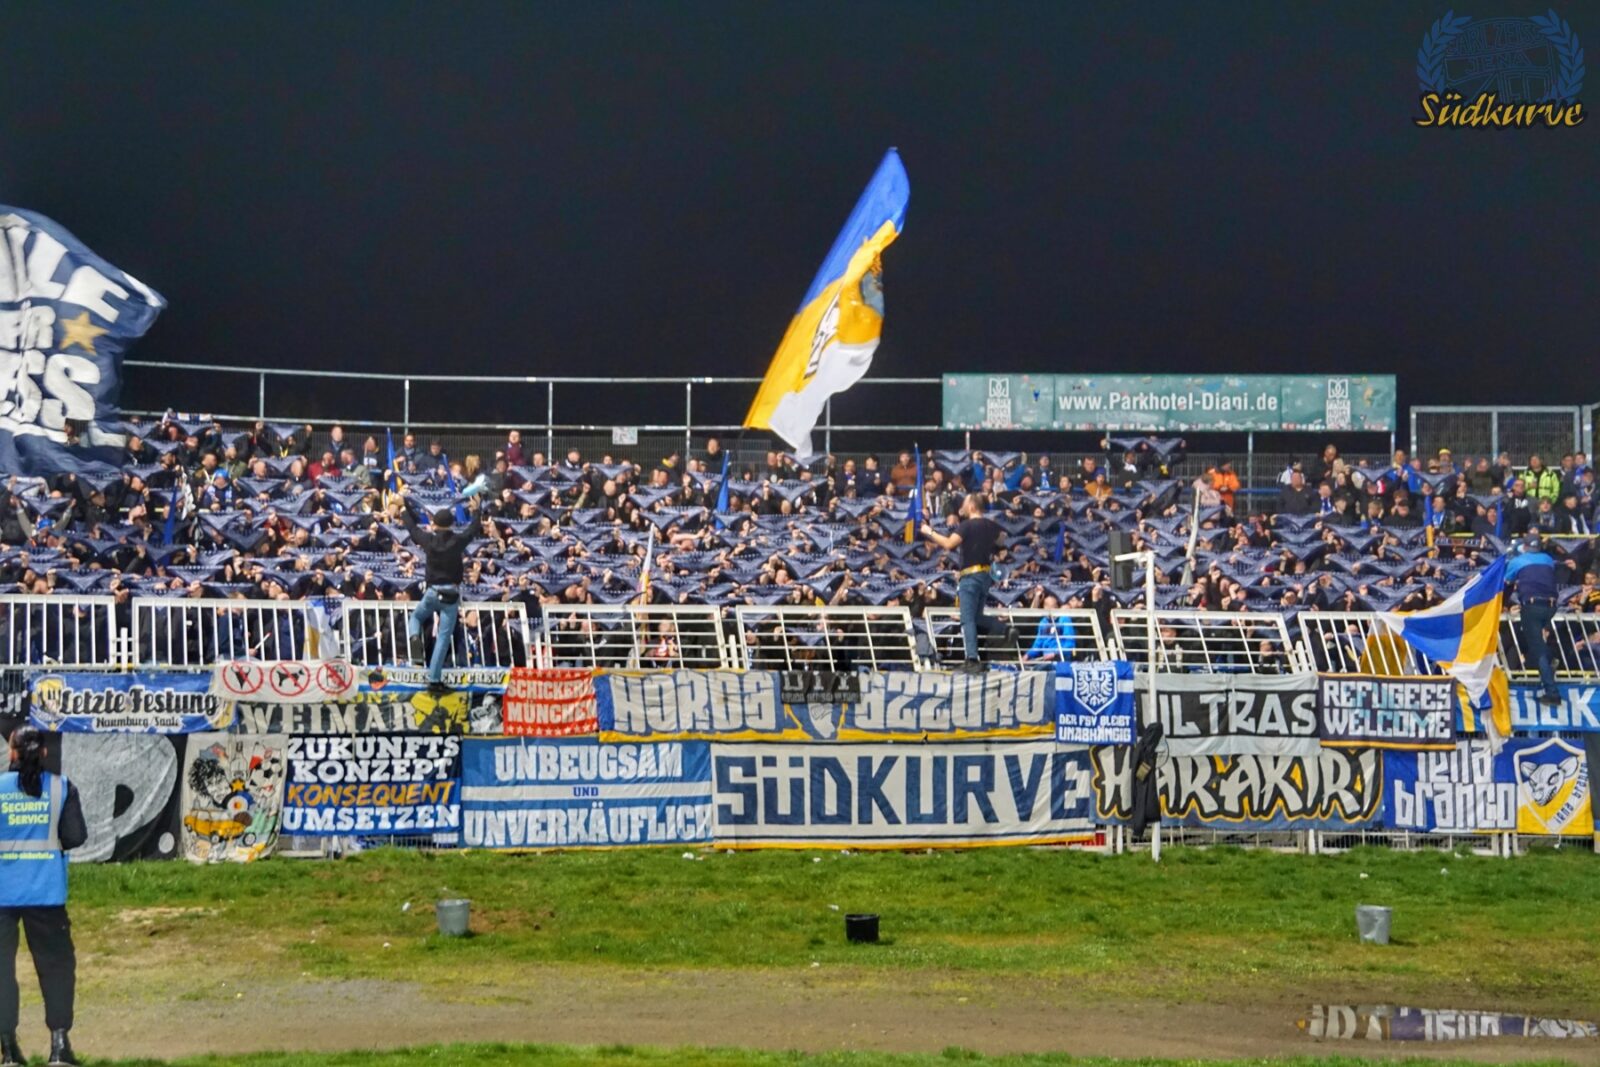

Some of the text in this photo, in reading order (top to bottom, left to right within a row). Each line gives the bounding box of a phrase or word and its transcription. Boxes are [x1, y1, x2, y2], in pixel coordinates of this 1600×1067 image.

[1059, 392, 1278, 411] www.Parkhotel-Diani.de
[467, 671, 506, 684] CREW
[60, 687, 220, 716] Letzte Festung
[1323, 681, 1452, 710] REFUGEES
[240, 703, 420, 733] WEIMAR
[507, 698, 598, 724] MÜNCHEN
[1059, 714, 1131, 727] DER FSV BLEIBT
[1141, 692, 1317, 736] ULTRAS
[1323, 708, 1451, 738] WELCOME
[1059, 725, 1131, 742] UNABHÄNGIG
[287, 736, 460, 760] ZUKUNFTS
[292, 758, 453, 783] KONZEPT
[494, 743, 683, 781] UNBEUGSAM
[287, 781, 455, 807] KONSEQUENT
[573, 787, 599, 797] UND
[715, 751, 1090, 826] SÜDKURVE
[2, 801, 49, 813] SECURITY
[1394, 779, 1516, 829] branco
[8, 813, 49, 825] SERVICE
[282, 804, 461, 831] UMSETZEN
[463, 802, 713, 847] UNVERKÄUFLICH
